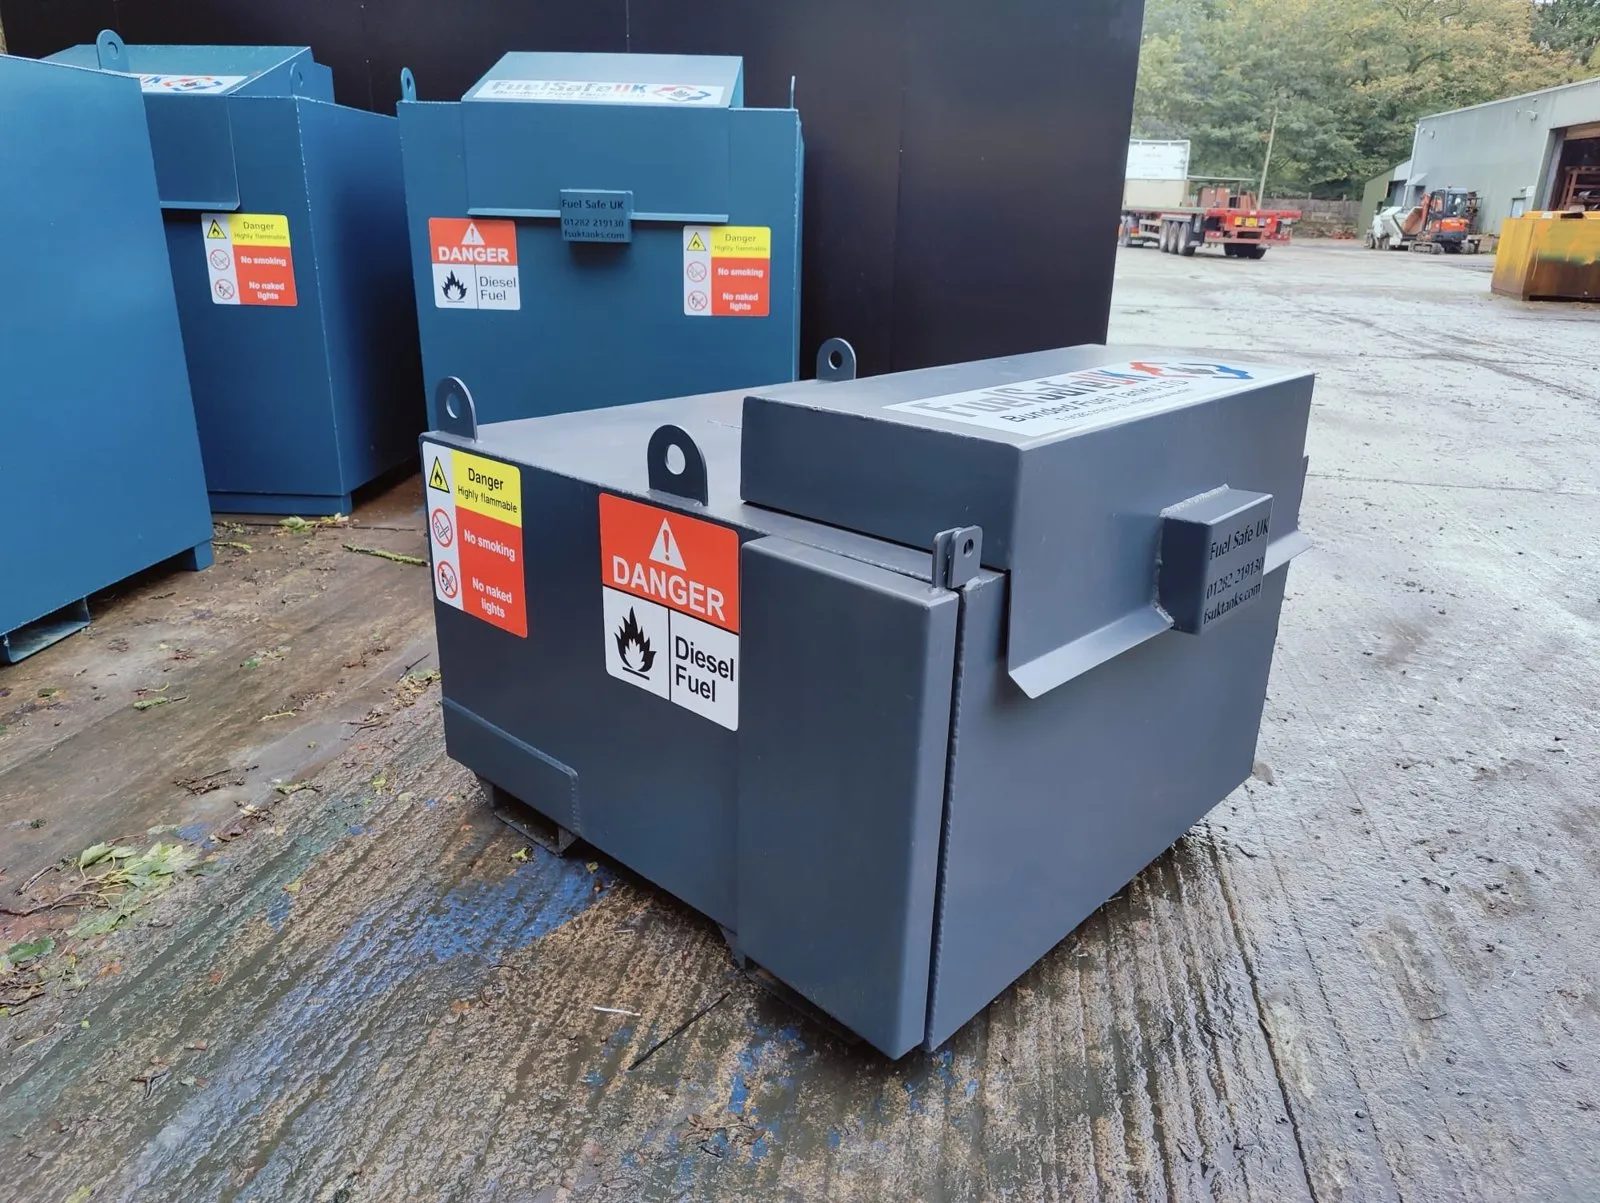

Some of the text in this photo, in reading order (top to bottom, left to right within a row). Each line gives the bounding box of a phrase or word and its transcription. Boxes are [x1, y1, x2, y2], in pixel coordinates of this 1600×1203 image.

[562, 199, 624, 210] Fuel Safe UK
[243, 221, 274, 231] Danger
[564, 218, 624, 228] 01282 219130
[564, 229, 625, 239] fsuktanks.com
[725, 233, 757, 244] Danger
[240, 255, 287, 267] No smoking
[438, 246, 510, 263] DANGER
[717, 267, 764, 278] No smoking
[248, 281, 285, 290] No naked
[479, 276, 516, 288] Diesel
[257, 291, 279, 301] lights
[480, 289, 506, 301] Fuel
[722, 292, 759, 301] No naked
[729, 302, 751, 311] lights
[1000, 402, 1081, 423] Bunded
[468, 467, 504, 491] Danger
[457, 484, 518, 514] Highly flammable
[463, 528, 515, 562] No smoking
[1209, 516, 1270, 560] Fuel Safe UK
[1206, 556, 1264, 600] 01282 219130
[472, 576, 513, 604] No naked
[612, 555, 726, 622] DANGER
[481, 597, 505, 619] lights
[1203, 583, 1261, 625] fsuktanks.com
[675, 635, 735, 682] Diesel
[675, 665, 716, 702] Fuel
